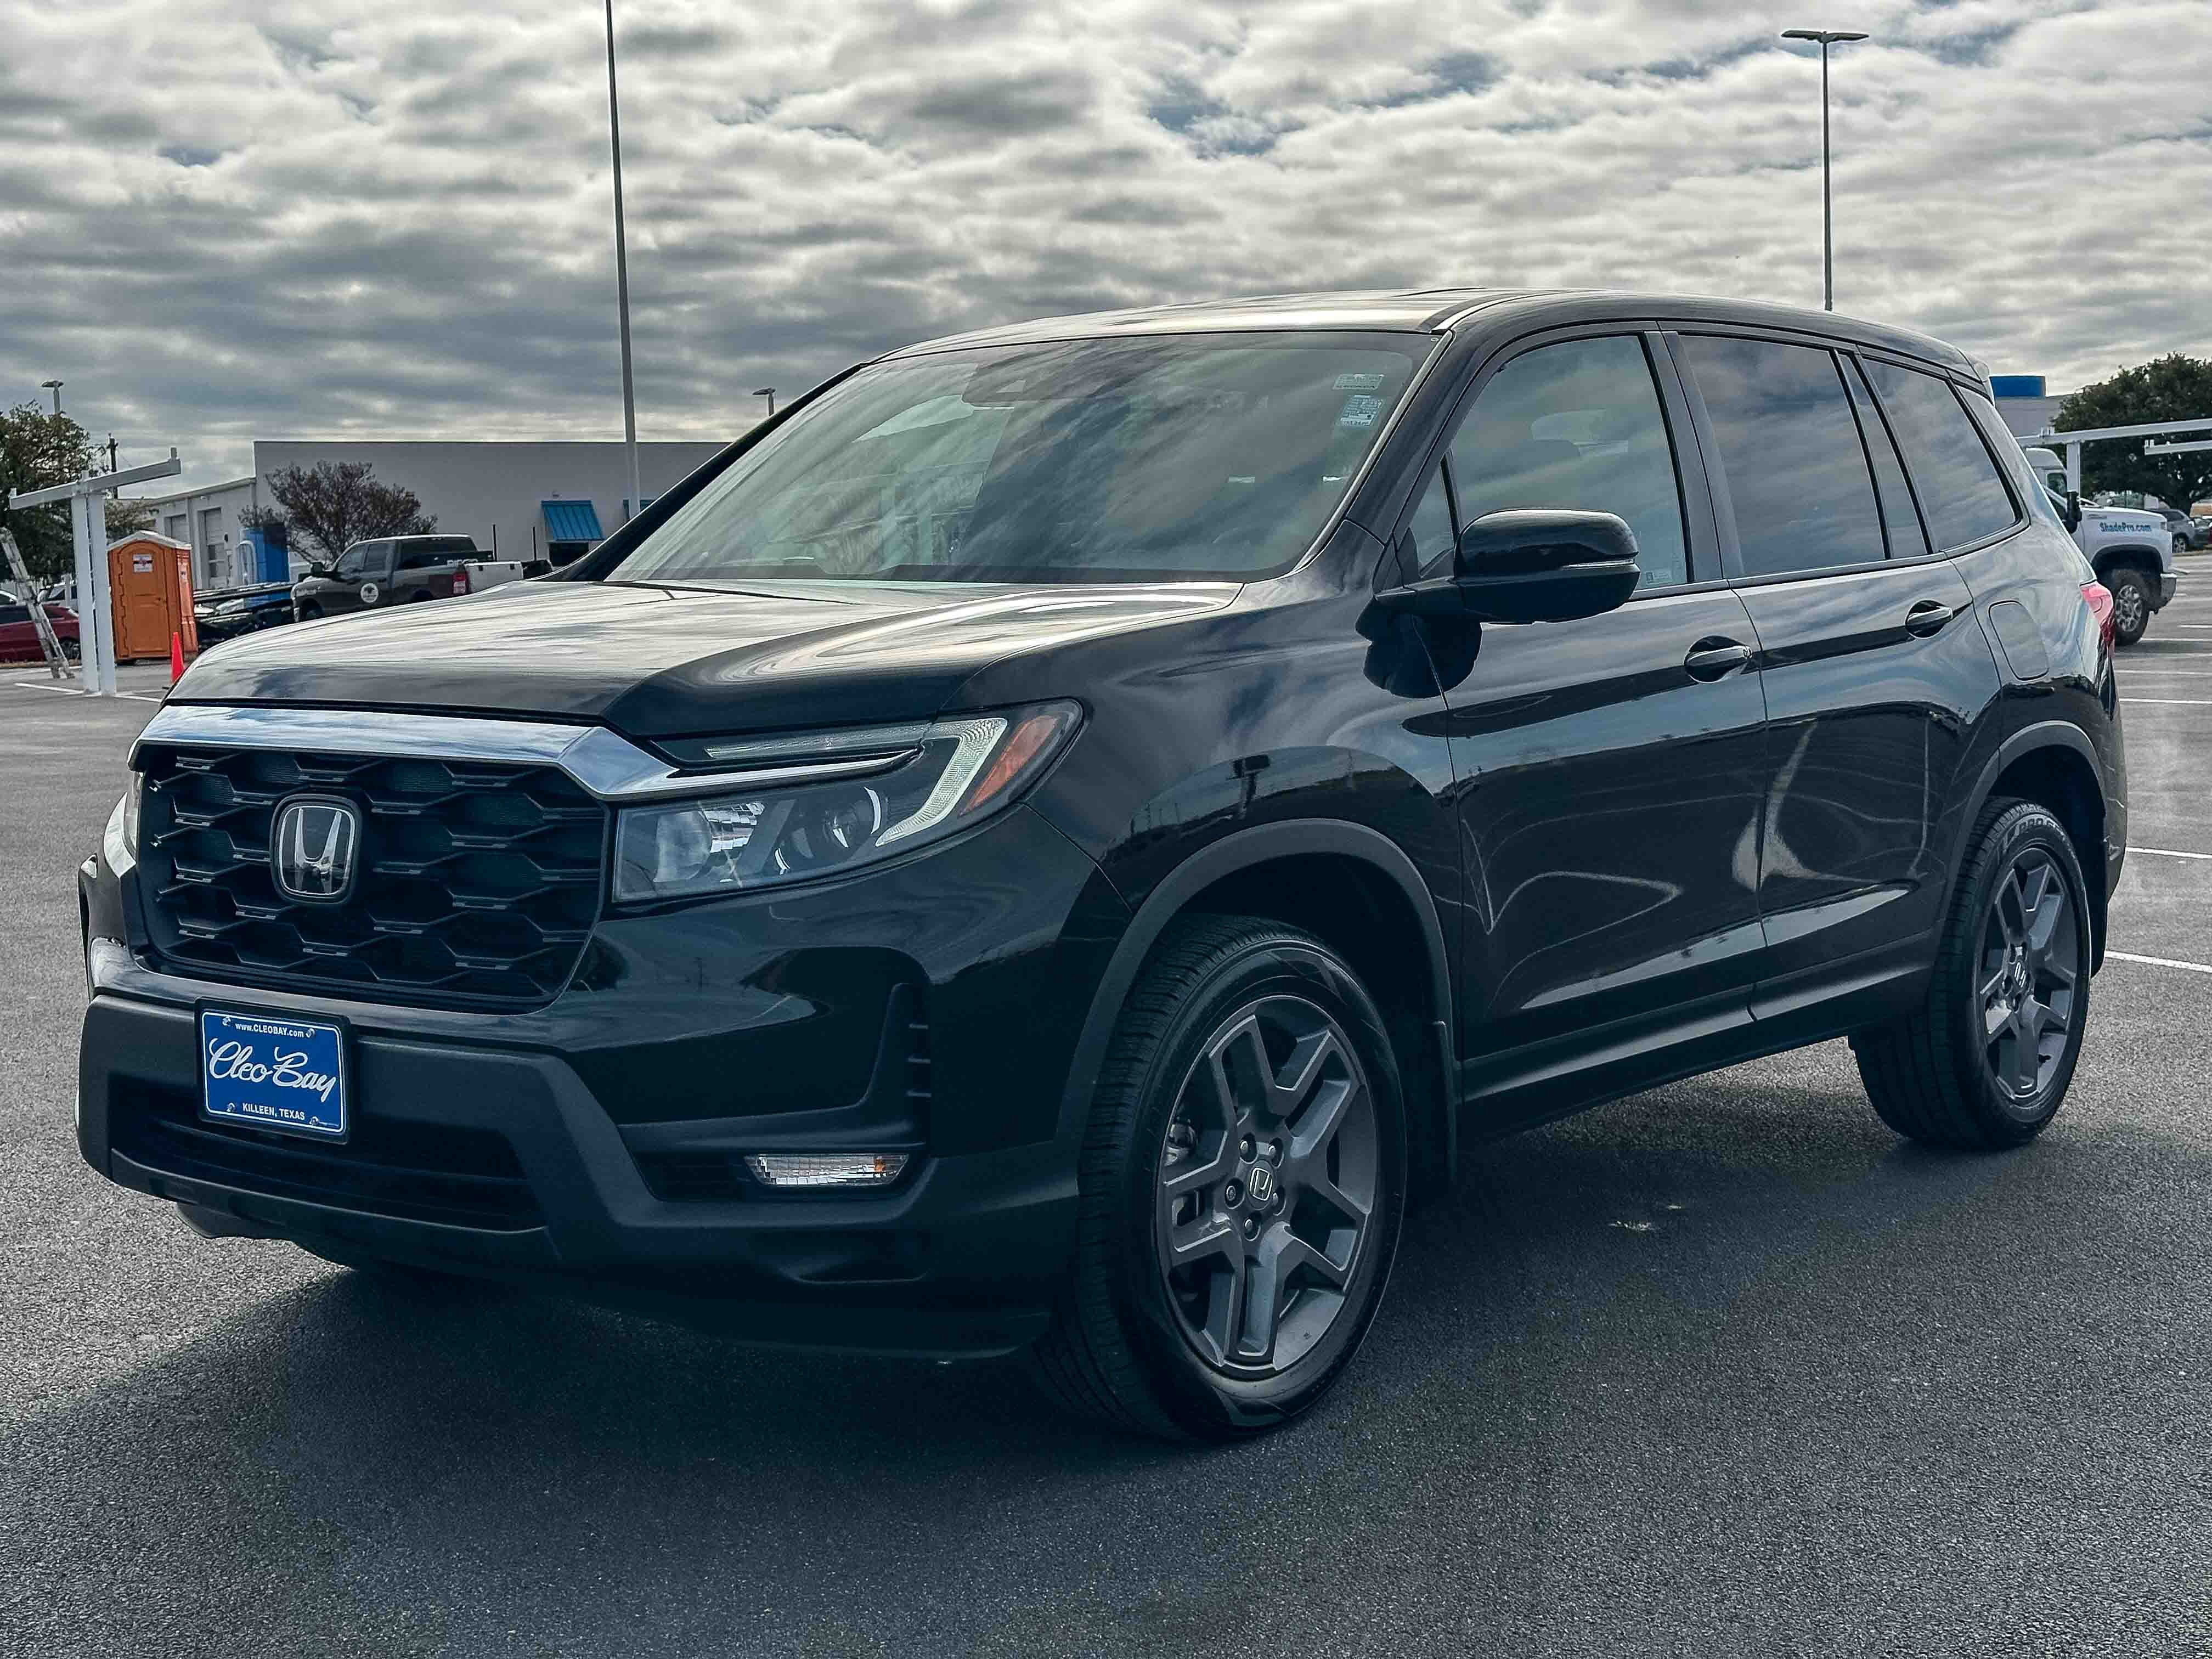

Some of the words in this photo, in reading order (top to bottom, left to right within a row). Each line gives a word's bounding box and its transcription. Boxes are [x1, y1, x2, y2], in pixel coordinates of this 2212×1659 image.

[235, 1022, 304, 1038] www.CLEOBAY.com
[208, 1037, 273, 1083] Cleo
[272, 1046, 337, 1103] Bay
[242, 1103, 278, 1118] KILLEEN,
[279, 1108, 305, 1120] TEXAS
